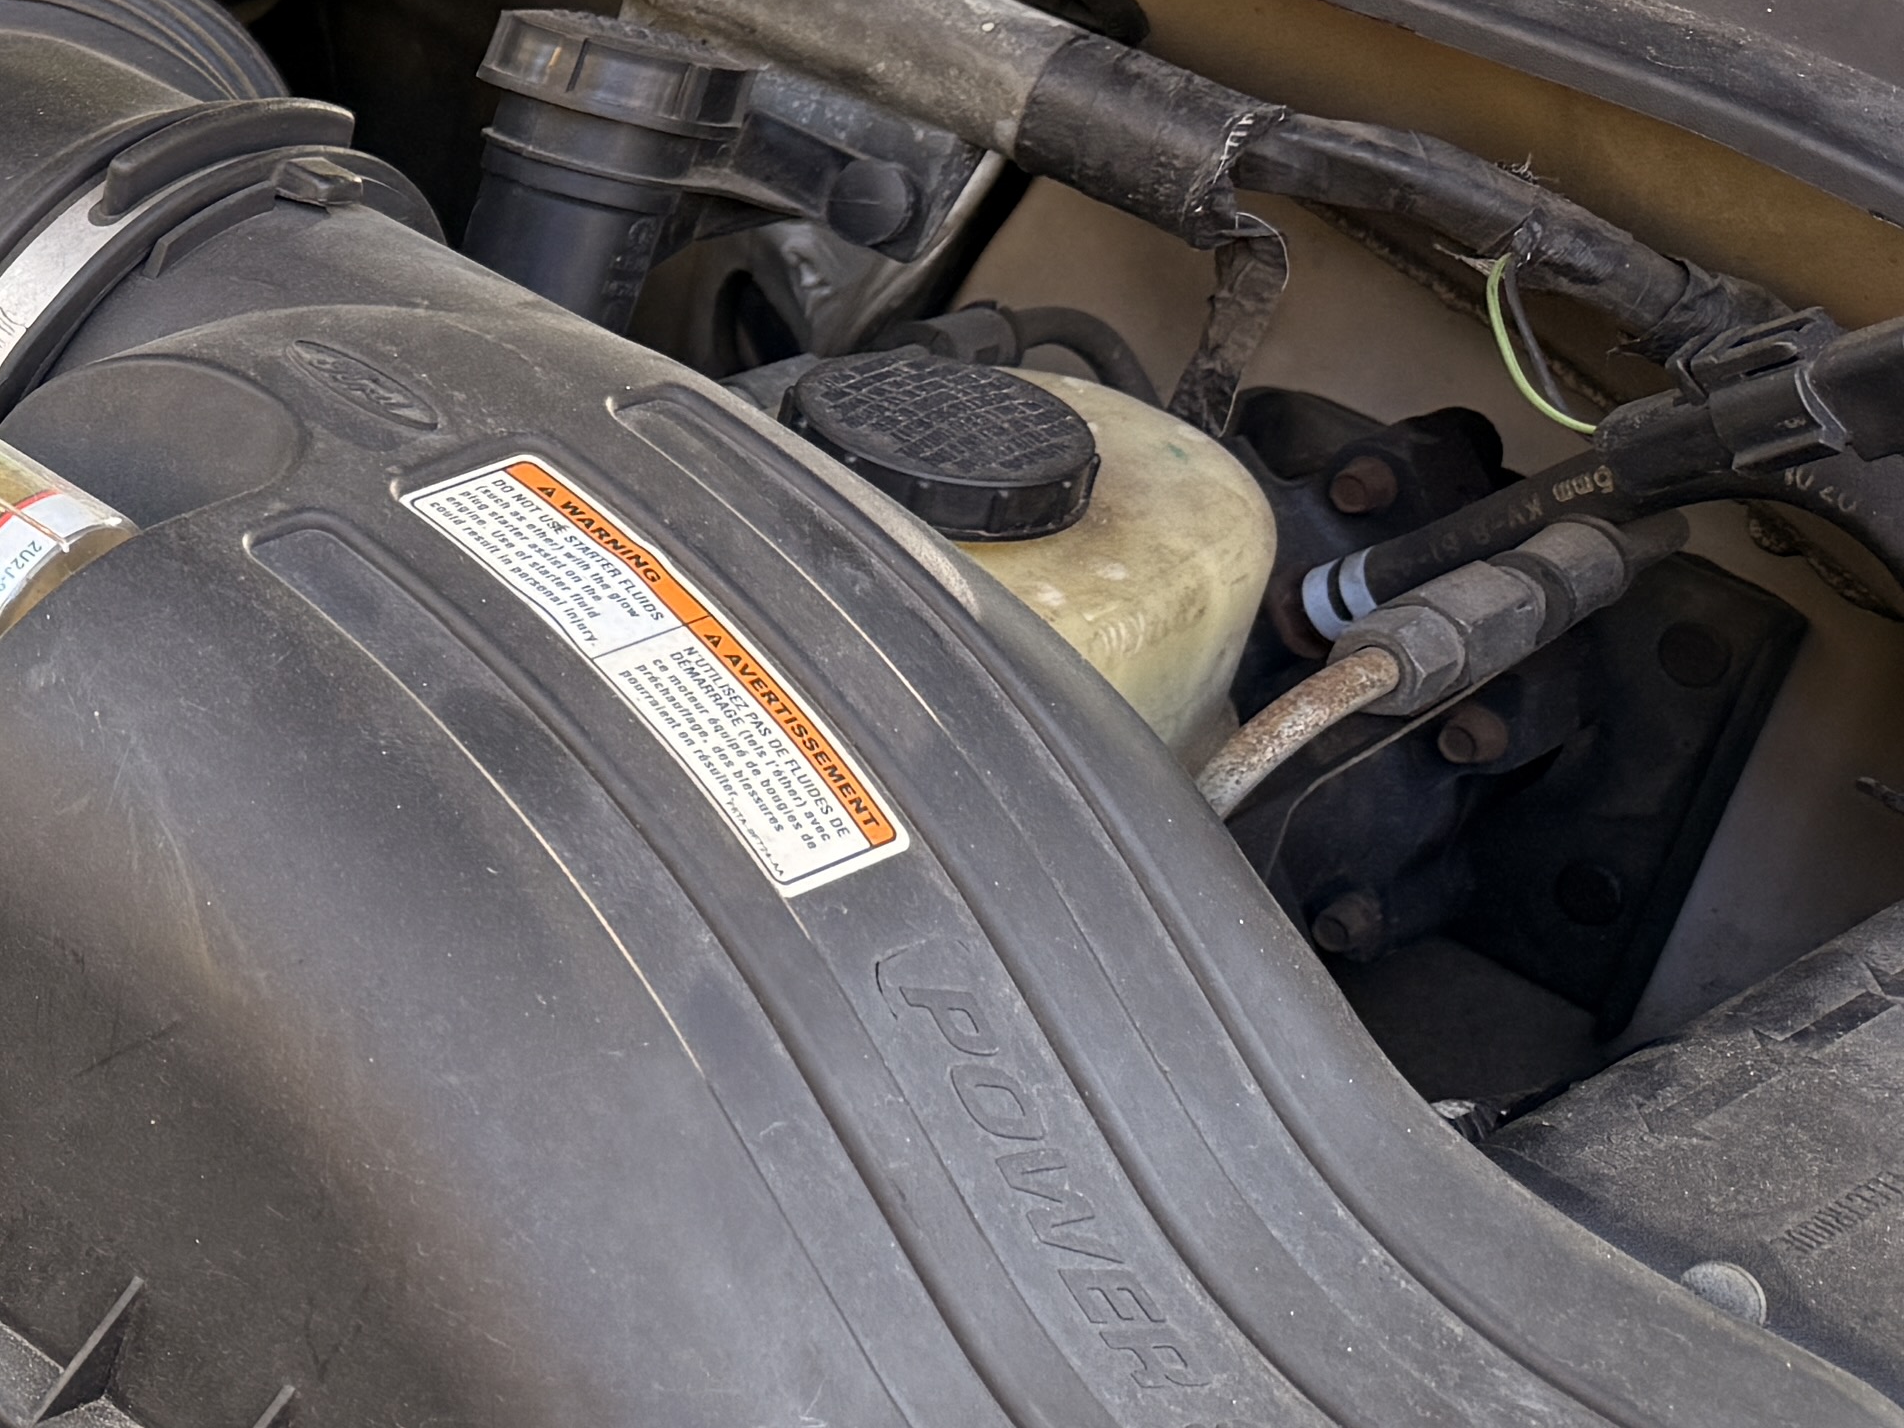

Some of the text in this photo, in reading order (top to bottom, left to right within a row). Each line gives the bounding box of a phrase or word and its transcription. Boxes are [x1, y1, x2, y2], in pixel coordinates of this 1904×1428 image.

[490, 477, 514, 494] DO
[510, 492, 542, 515] NOT
[563, 533, 622, 578] STARTER
[617, 577, 666, 622] FLUIDS
[560, 501, 661, 584] WARNING
[725, 654, 880, 828] AVERTISSEMENT
[899, 984, 1209, 1389] POWER
